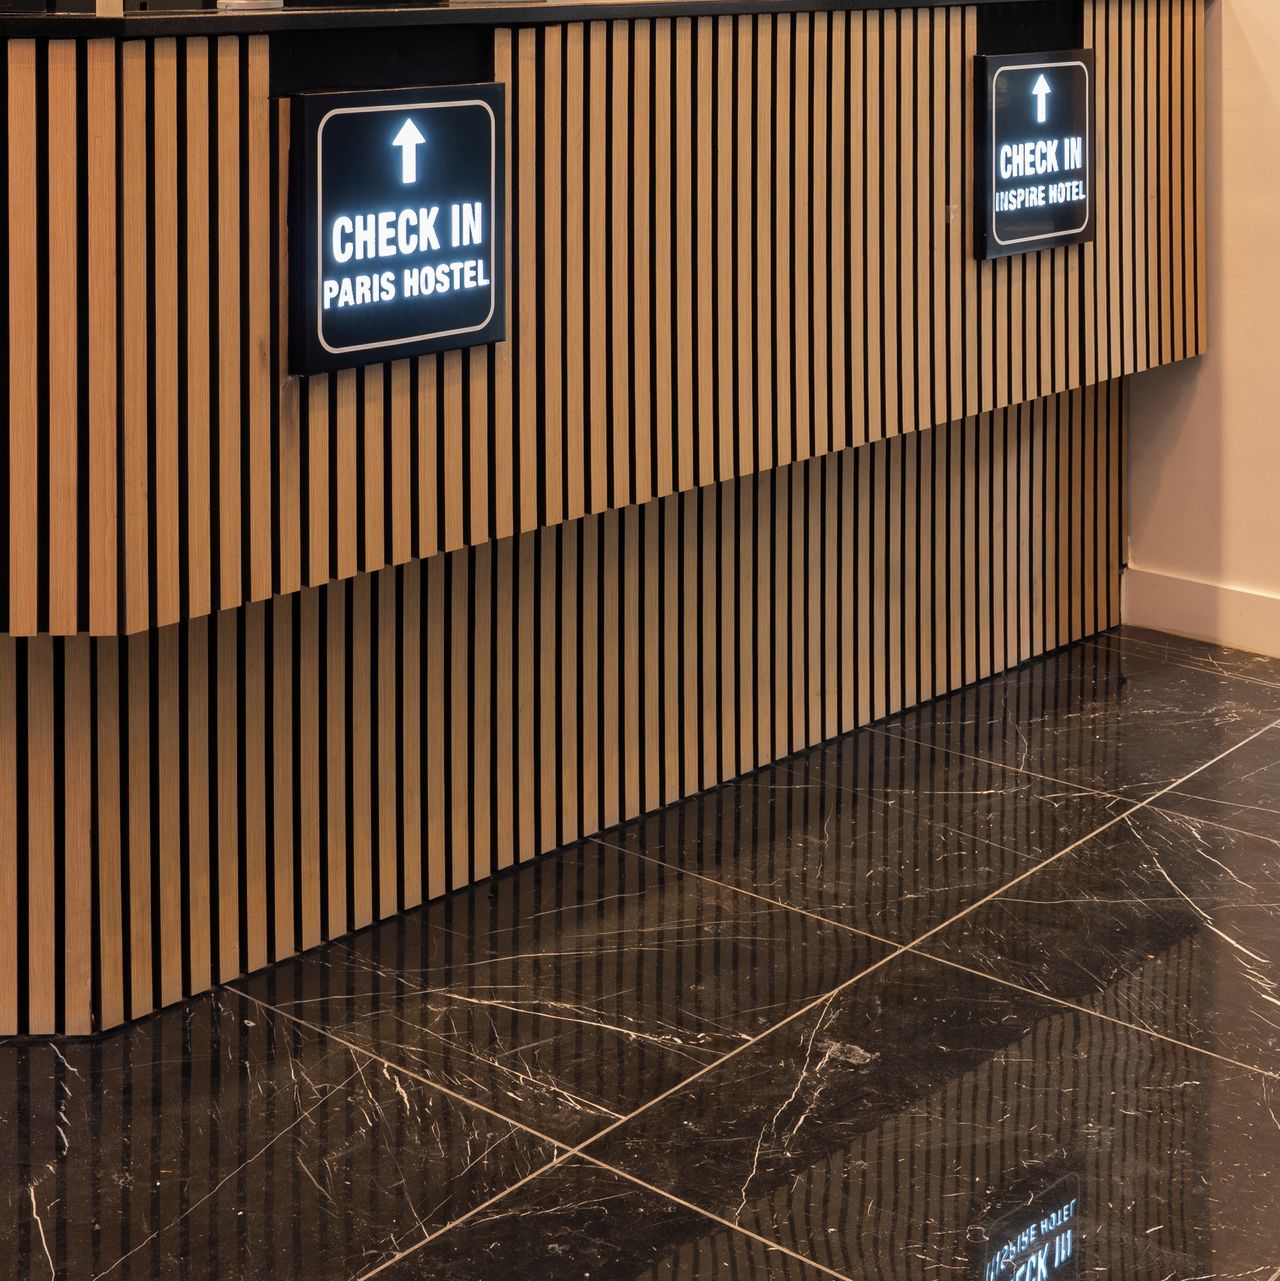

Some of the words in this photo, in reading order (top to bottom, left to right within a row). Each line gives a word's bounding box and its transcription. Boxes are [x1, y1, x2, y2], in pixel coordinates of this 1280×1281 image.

[1000, 139, 1059, 180] CHECK
[1064, 136, 1082, 171] IN
[995, 186, 1046, 212] INSPIRE
[1049, 180, 1086, 205] HOTEL
[332, 207, 440, 263] CHECK
[451, 202, 482, 247] IN
[323, 272, 395, 309] PARIS
[404, 259, 490, 298] HOSTEL
